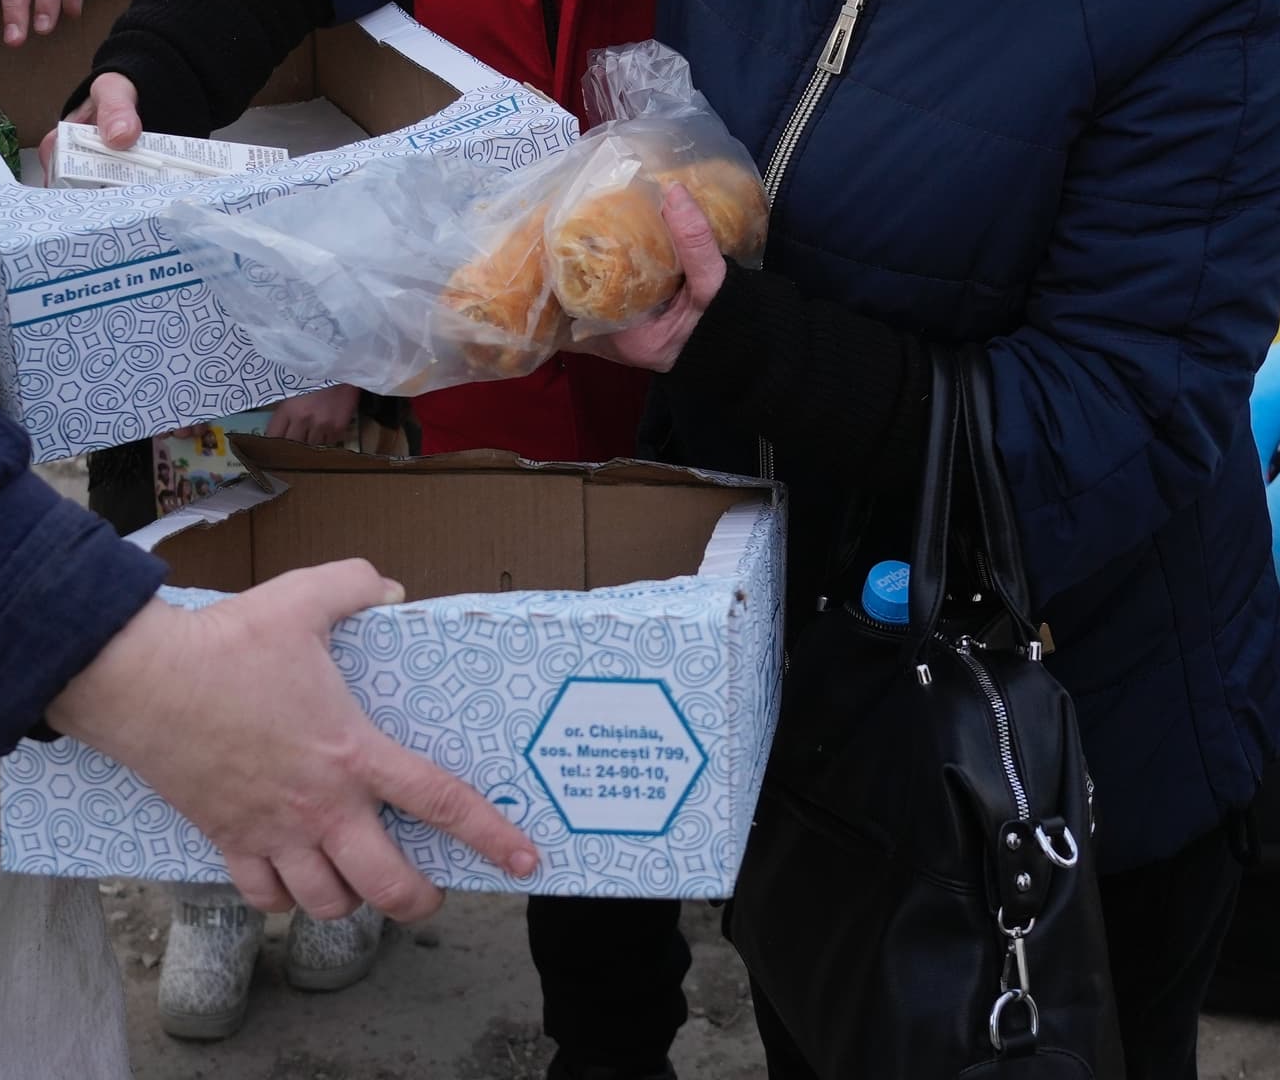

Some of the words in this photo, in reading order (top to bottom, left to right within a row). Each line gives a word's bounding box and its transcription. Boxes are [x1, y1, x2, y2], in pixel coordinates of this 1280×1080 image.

[416, 104, 510, 142] Steviprod
[41, 277, 121, 308] Fabricat
[127, 272, 144, 286] în
[564, 726, 584, 738] or.
[655, 747, 690, 763] 799,
[560, 765, 591, 777] tel.:
[595, 765, 669, 783] 24-90-10,
[563, 784, 593, 797] fax:
[598, 785, 666, 800] 24-91-26
